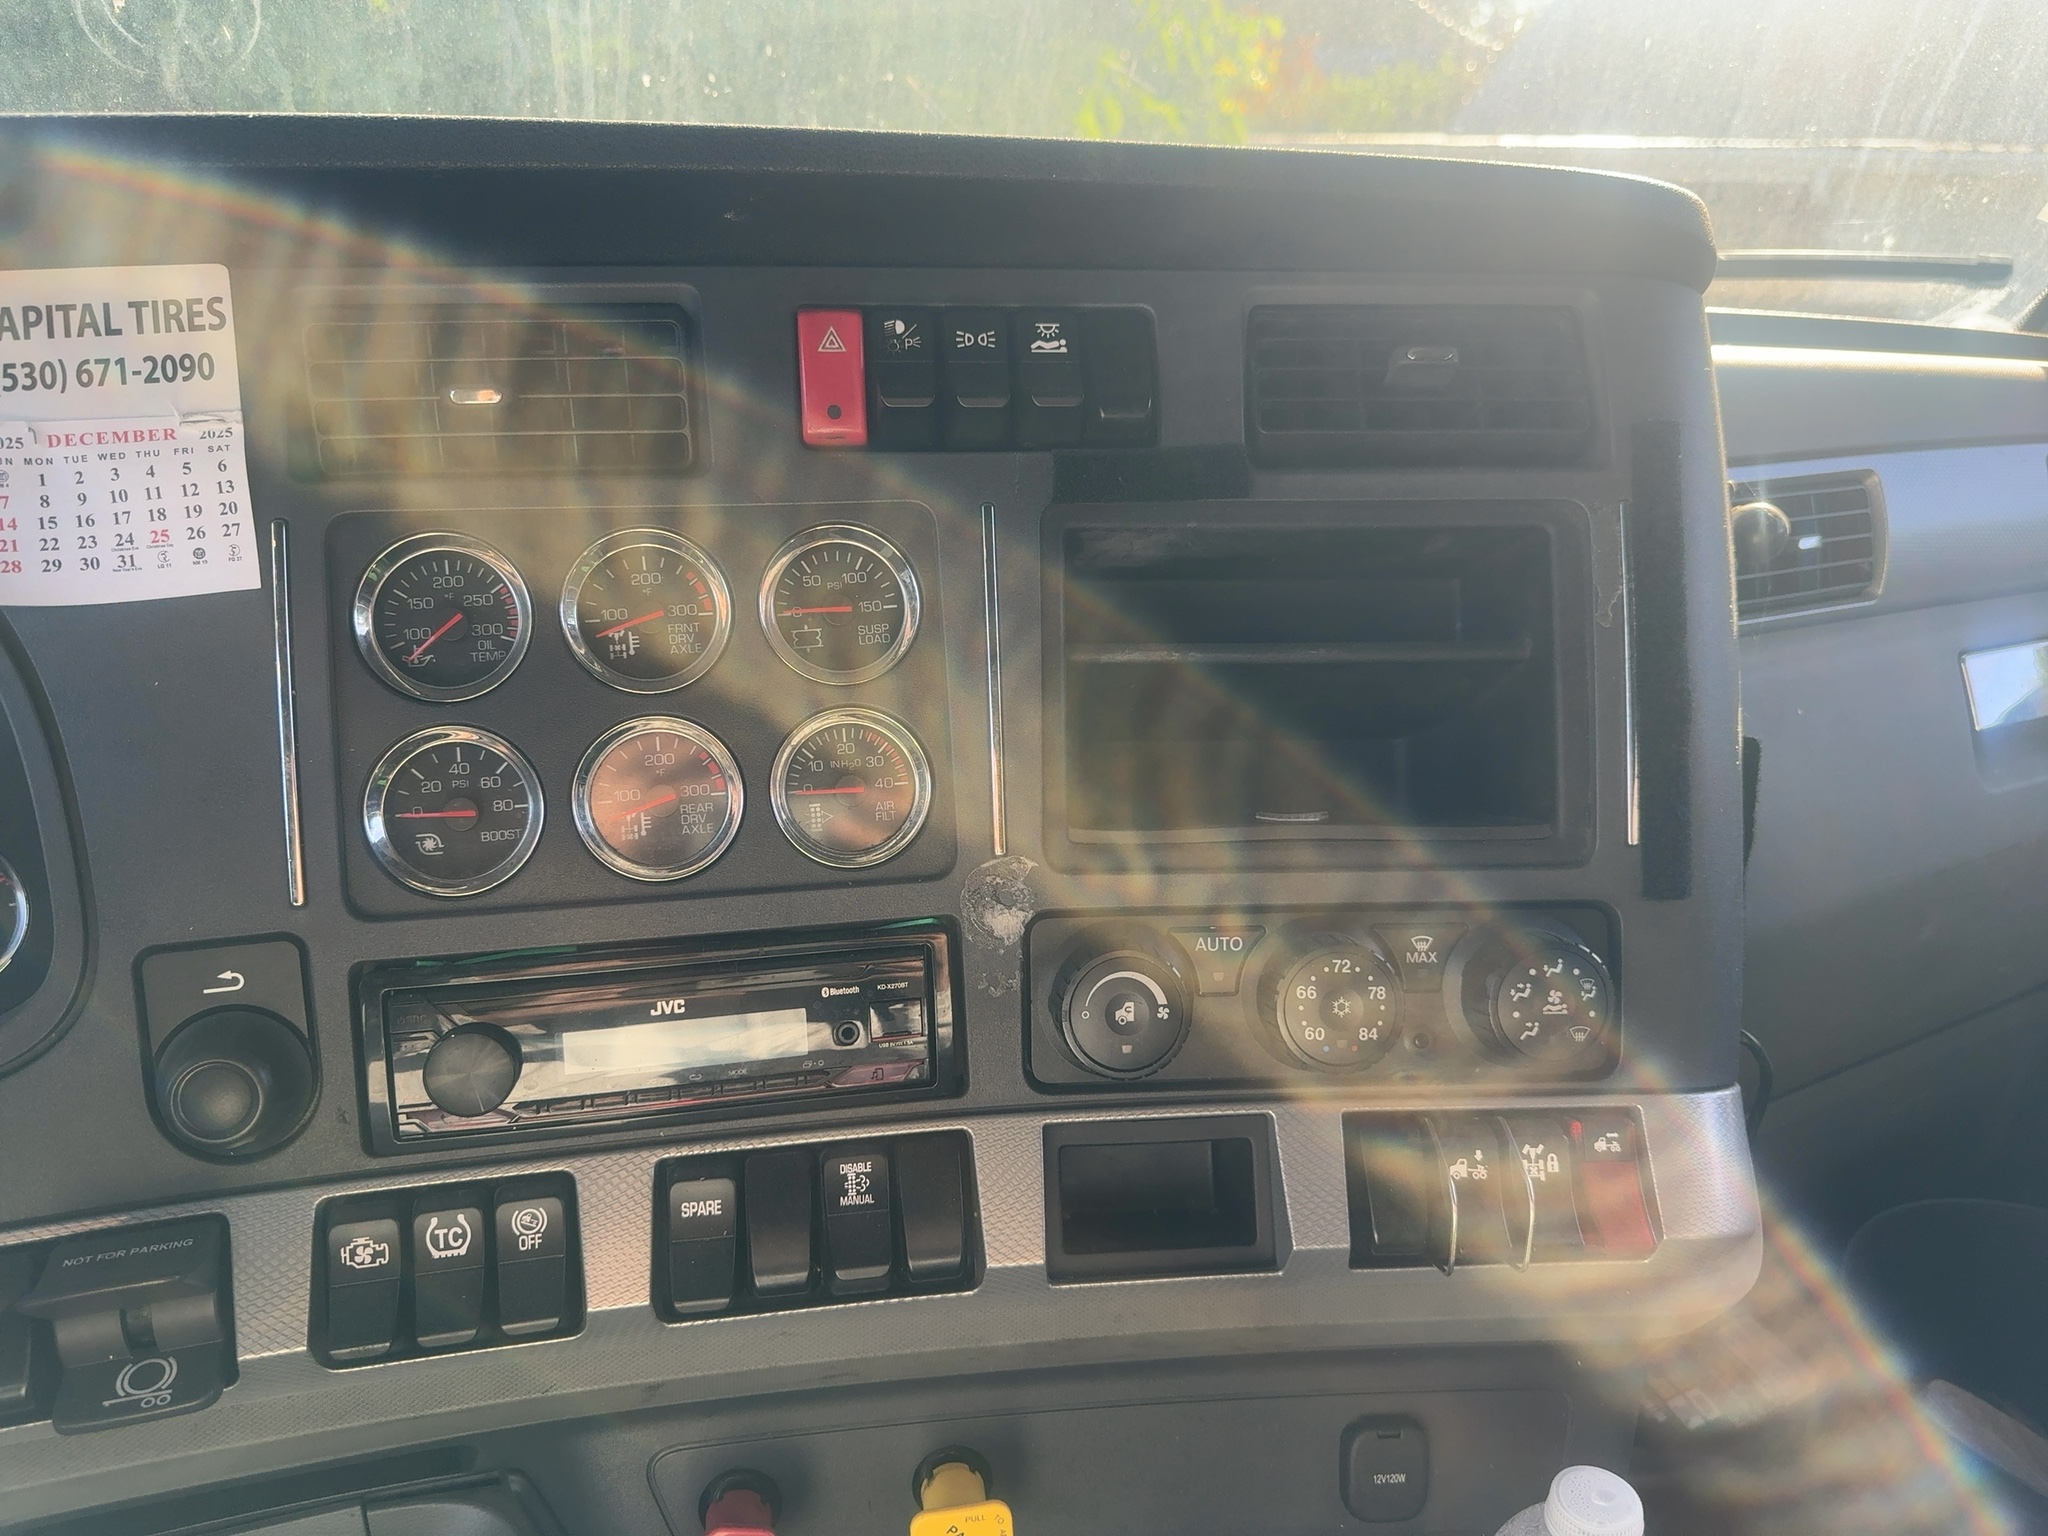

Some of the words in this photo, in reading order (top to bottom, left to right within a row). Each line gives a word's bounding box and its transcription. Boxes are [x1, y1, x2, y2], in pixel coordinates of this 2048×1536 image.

[128, 296, 227, 335] TIRES
[0, 358, 67, 398] 530)
[75, 352, 215, 388] 671-2090
[47, 428, 177, 448] DECEMBER
[24, 457, 54, 466] MON
[64, 455, 88, 464] TUE
[98, 452, 126, 461] WED
[136, 449, 161, 458] THU
[173, 447, 194, 455] FRI
[207, 444, 231, 453] SAT
[39, 473, 46, 487] 1
[74, 471, 85, 485] 2
[110, 467, 120, 481] 3
[146, 464, 156, 478] 4
[182, 461, 192, 475] 5
[217, 459, 228, 472] 6
[0, 495, 9, 509] 7
[40, 494, 50, 509] 8
[77, 492, 87, 506] 9
[110, 489, 128, 503] 10
[145, 486, 163, 500] 11
[182, 483, 200, 497] 12
[217, 480, 235, 494] 13
[0, 517, 18, 531] 14
[38, 516, 58, 530] 15
[76, 514, 96, 529] 16
[113, 511, 131, 526] 17
[149, 508, 167, 522] 18
[185, 504, 203, 519] 19
[219, 501, 238, 516] 20
[0, 539, 19, 552] 21
[39, 538, 60, 552] 22
[78, 535, 98, 550] 23
[115, 532, 134, 547] 24
[150, 529, 170, 544] 25
[186, 526, 206, 541] 26
[222, 523, 241, 537] 27
[0, 560, 22, 573] 28
[41, 559, 62, 572] 29
[79, 557, 100, 571] 30
[117, 554, 136, 568] 31
[433, 575, 464, 589] 200
[631, 572, 662, 586] 200
[803, 575, 822, 588] 50
[841, 571, 867, 585] 100
[827, 582, 843, 591] PSI
[407, 597, 434, 610] 150
[463, 594, 494, 607] 250
[858, 600, 882, 613] 150
[601, 608, 628, 621] 100
[667, 604, 698, 617] 300
[792, 606, 803, 618] 0
[403, 627, 431, 640] 100
[472, 623, 503, 637] 300
[667, 622, 701, 634] FRNT
[857, 624, 890, 636] SUSP
[477, 640, 496, 651] OIL
[669, 634, 695, 645] DRV
[859, 634, 891, 645] LOAD
[670, 643, 702, 655] AXLE
[470, 651, 507, 663] TEMP
[836, 742, 855, 755] 20
[644, 753, 675, 767] 200
[809, 760, 823, 772] 10
[865, 755, 884, 768] 30
[449, 762, 470, 775] 40
[421, 780, 442, 793] 20
[452, 780, 470, 789] PSI
[480, 776, 502, 789] 60
[875, 777, 894, 789] 40
[614, 789, 641, 802] 100
[680, 784, 711, 797] 300
[493, 799, 514, 812] 80
[680, 802, 714, 814] REAR
[875, 801, 895, 811] AIR
[681, 814, 707, 826] DRV
[875, 811, 896, 821] FILT
[481, 828, 522, 843] BOOST
[681, 823, 714, 835] AXLE
[1195, 936, 1243, 951] AUTO
[1406, 951, 1438, 964] MAX
[1332, 959, 1352, 974] 72
[830, 986, 860, 996] Bluetooth
[1296, 986, 1317, 1000] 66
[1367, 986, 1386, 1000] 78
[650, 999, 685, 1016] JVC
[1304, 1027, 1325, 1041] 60
[1358, 1027, 1378, 1041] 84
[839, 1161, 872, 1174] DISABLE
[839, 1193, 875, 1206] MANUAL
[681, 1199, 722, 1218] SPARE
[434, 1228, 463, 1249] TC
[519, 1233, 542, 1251] OFF
[62, 1255, 93, 1267] NOT
[96, 1249, 126, 1261] FOR
[129, 1238, 194, 1256] PARKING
[1373, 1473, 1406, 1484] 12V120W
[965, 1514, 986, 1523] PULL
[994, 1513, 1005, 1525] TO
